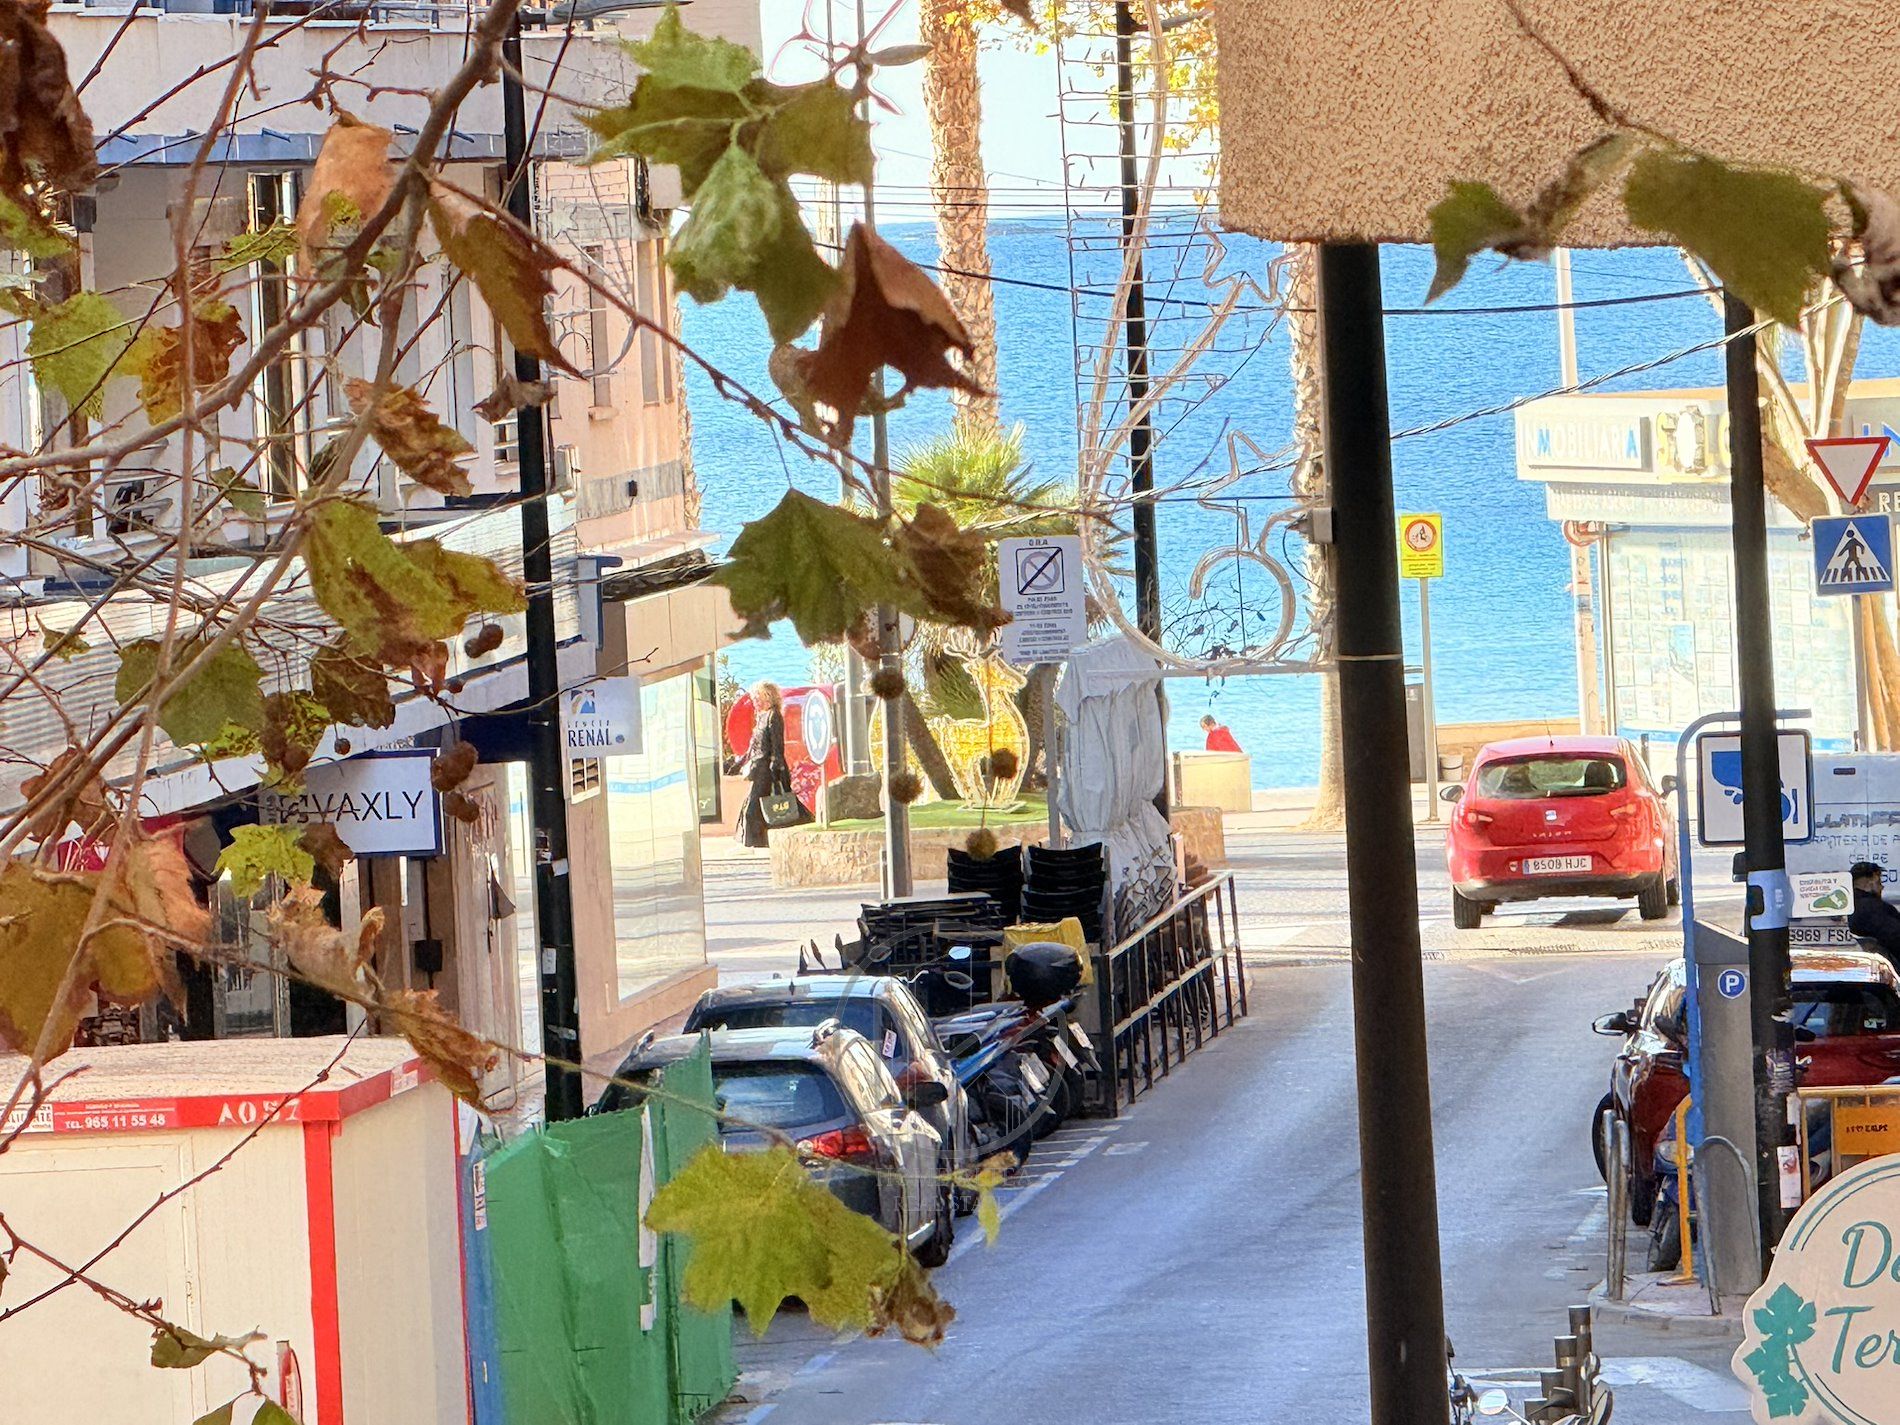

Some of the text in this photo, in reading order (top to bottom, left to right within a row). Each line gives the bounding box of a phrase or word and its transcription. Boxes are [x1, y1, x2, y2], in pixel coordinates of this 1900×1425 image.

[567, 728, 612, 747] RENAL
[1725, 975, 1739, 993] P
[112, 1114, 127, 1128] 11
[130, 1113, 147, 1127] 55
[149, 1112, 166, 1127] 48
